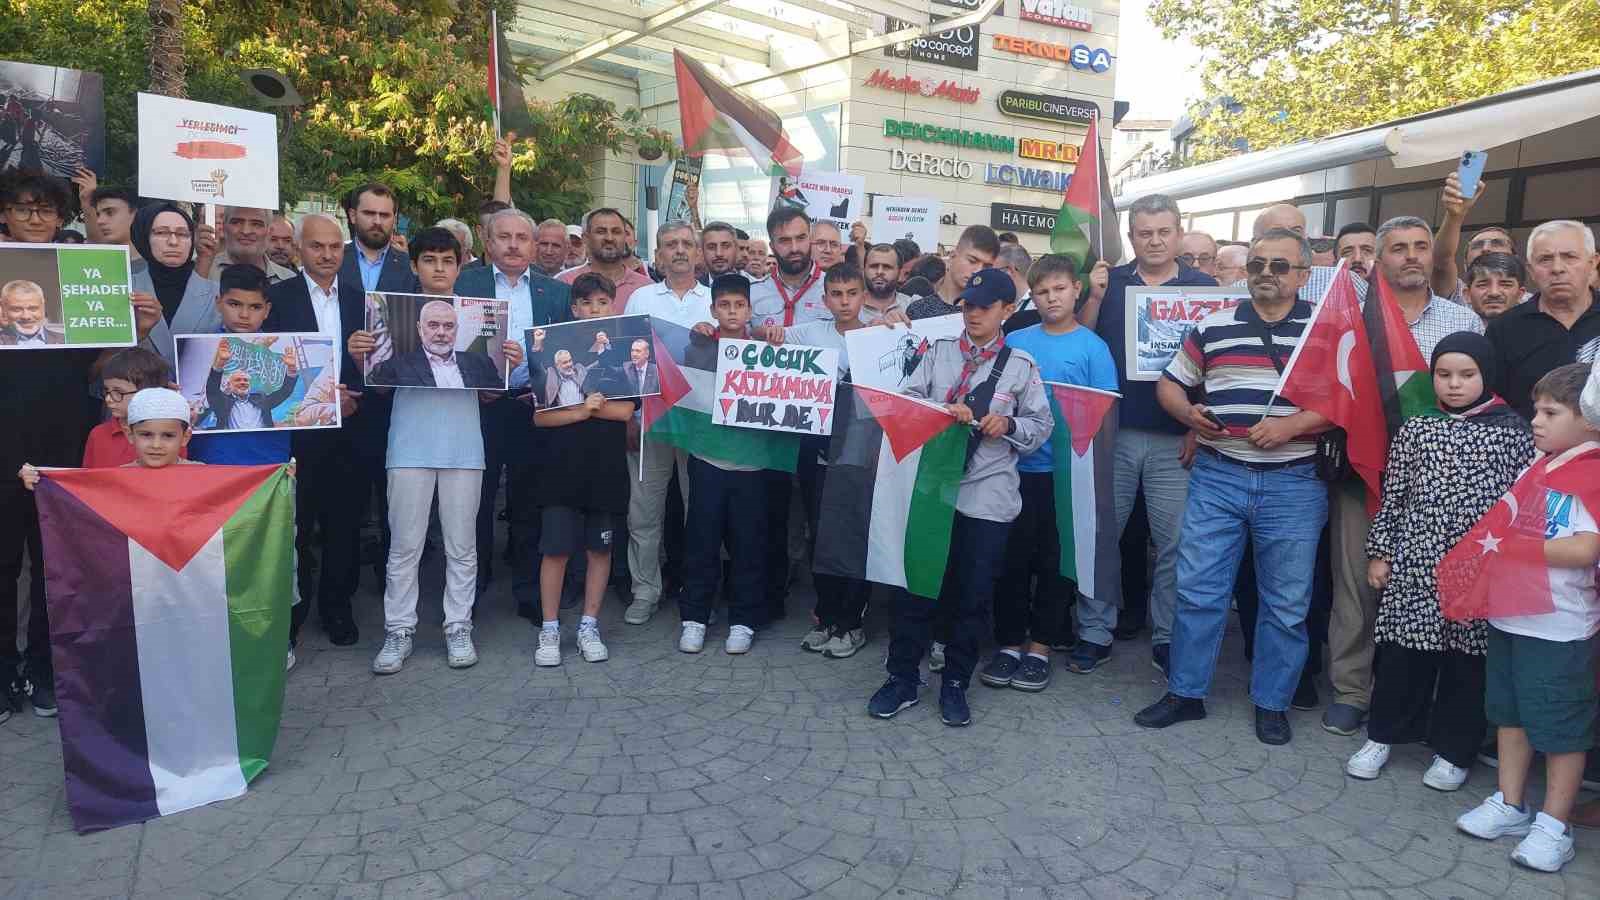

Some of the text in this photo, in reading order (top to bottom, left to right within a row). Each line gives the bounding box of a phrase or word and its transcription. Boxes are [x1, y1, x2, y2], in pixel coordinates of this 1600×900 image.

[1005, 96, 1095, 120] PARIBU CINEVERSE
[884, 118, 1015, 154] DEICHMANN
[891, 149, 974, 181] DeFacto
[1002, 212, 1056, 229] HATEMO
[83, 267, 102, 279] YA
[63, 284, 128, 298] ŞEHADET
[86, 301, 105, 312] YA
[69, 316, 127, 328] ZAFER...
[742, 344, 827, 375] ÇOCUK
[736, 398, 779, 427] DUR
